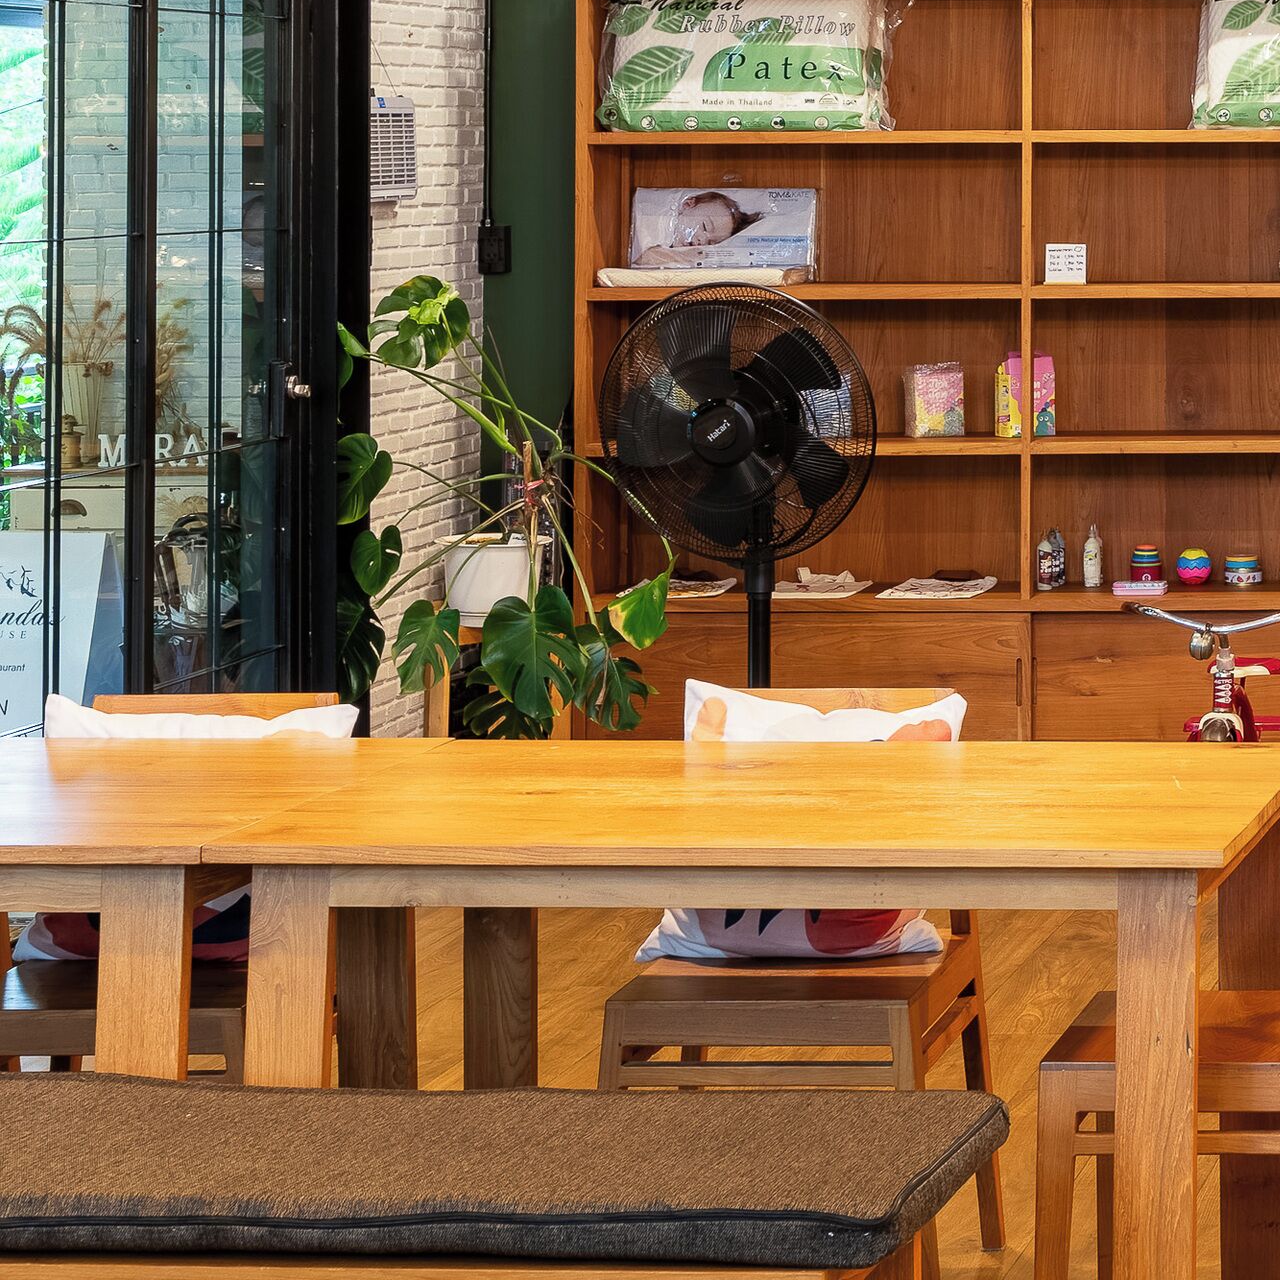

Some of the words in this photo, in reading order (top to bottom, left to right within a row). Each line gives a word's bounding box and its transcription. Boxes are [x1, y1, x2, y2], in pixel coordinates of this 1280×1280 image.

[678, 15, 764, 34] Rubber
[777, 15, 856, 37] Pillow
[723, 52, 845, 81] Patex
[702, 98, 724, 106] Made
[727, 98, 735, 106] in
[738, 98, 773, 107] Thailand
[706, 419, 731, 442] Hatari
